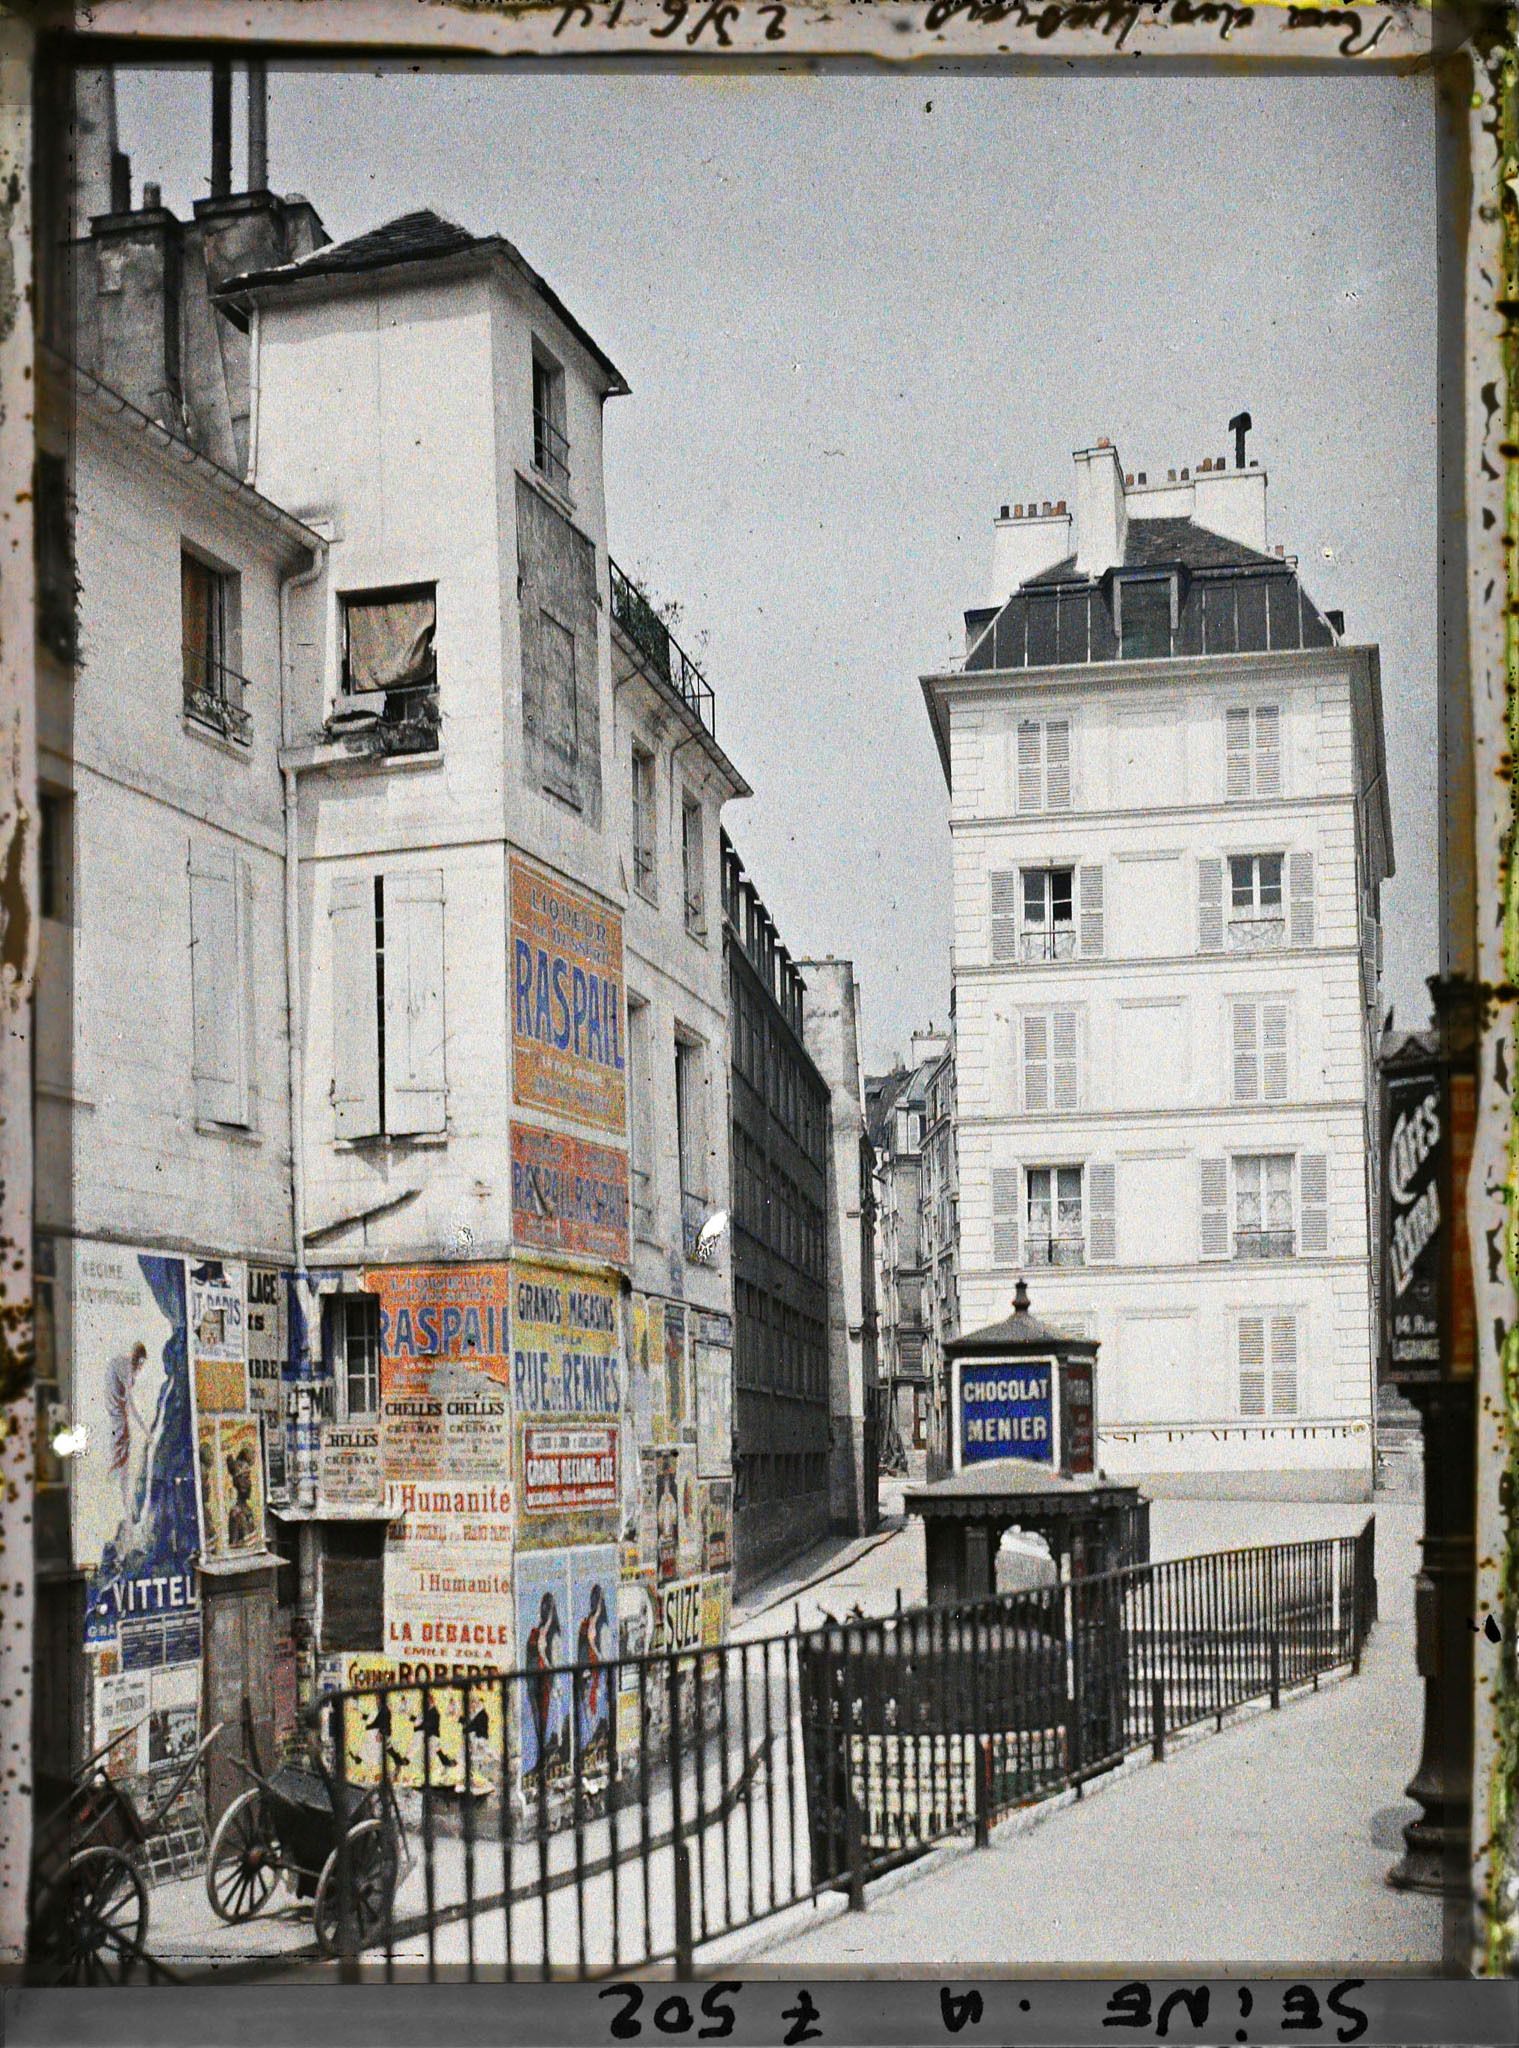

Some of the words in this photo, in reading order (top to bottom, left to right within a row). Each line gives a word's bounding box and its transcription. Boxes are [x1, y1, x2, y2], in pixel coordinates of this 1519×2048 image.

[514, 937, 625, 1071] RASPAIL
[518, 1283, 561, 1325] GRANDS
[515, 1350, 550, 1411] RUE
[562, 1353, 620, 1413] RENNES
[963, 1378, 1048, 1403] CHOCOLAT
[384, 1402, 442, 1416] CHELLES
[446, 1402, 505, 1416] CHELLES
[967, 1416, 1047, 1443] MENIER
[387, 1483, 511, 1514] l'Humanité
[112, 1574, 198, 1613] VITTEL
[390, 1621, 413, 1642] LA
[422, 1622, 508, 1645] DÉBACLE
[666, 1584, 699, 1651] SUZE
[404, 1647, 448, 1658] EMILE
[456, 1649, 493, 1659] ZOLA
[399, 1662, 499, 1691] ROBERT
[597, 1980, 743, 2039] 502
[940, 1986, 984, 2032] A
